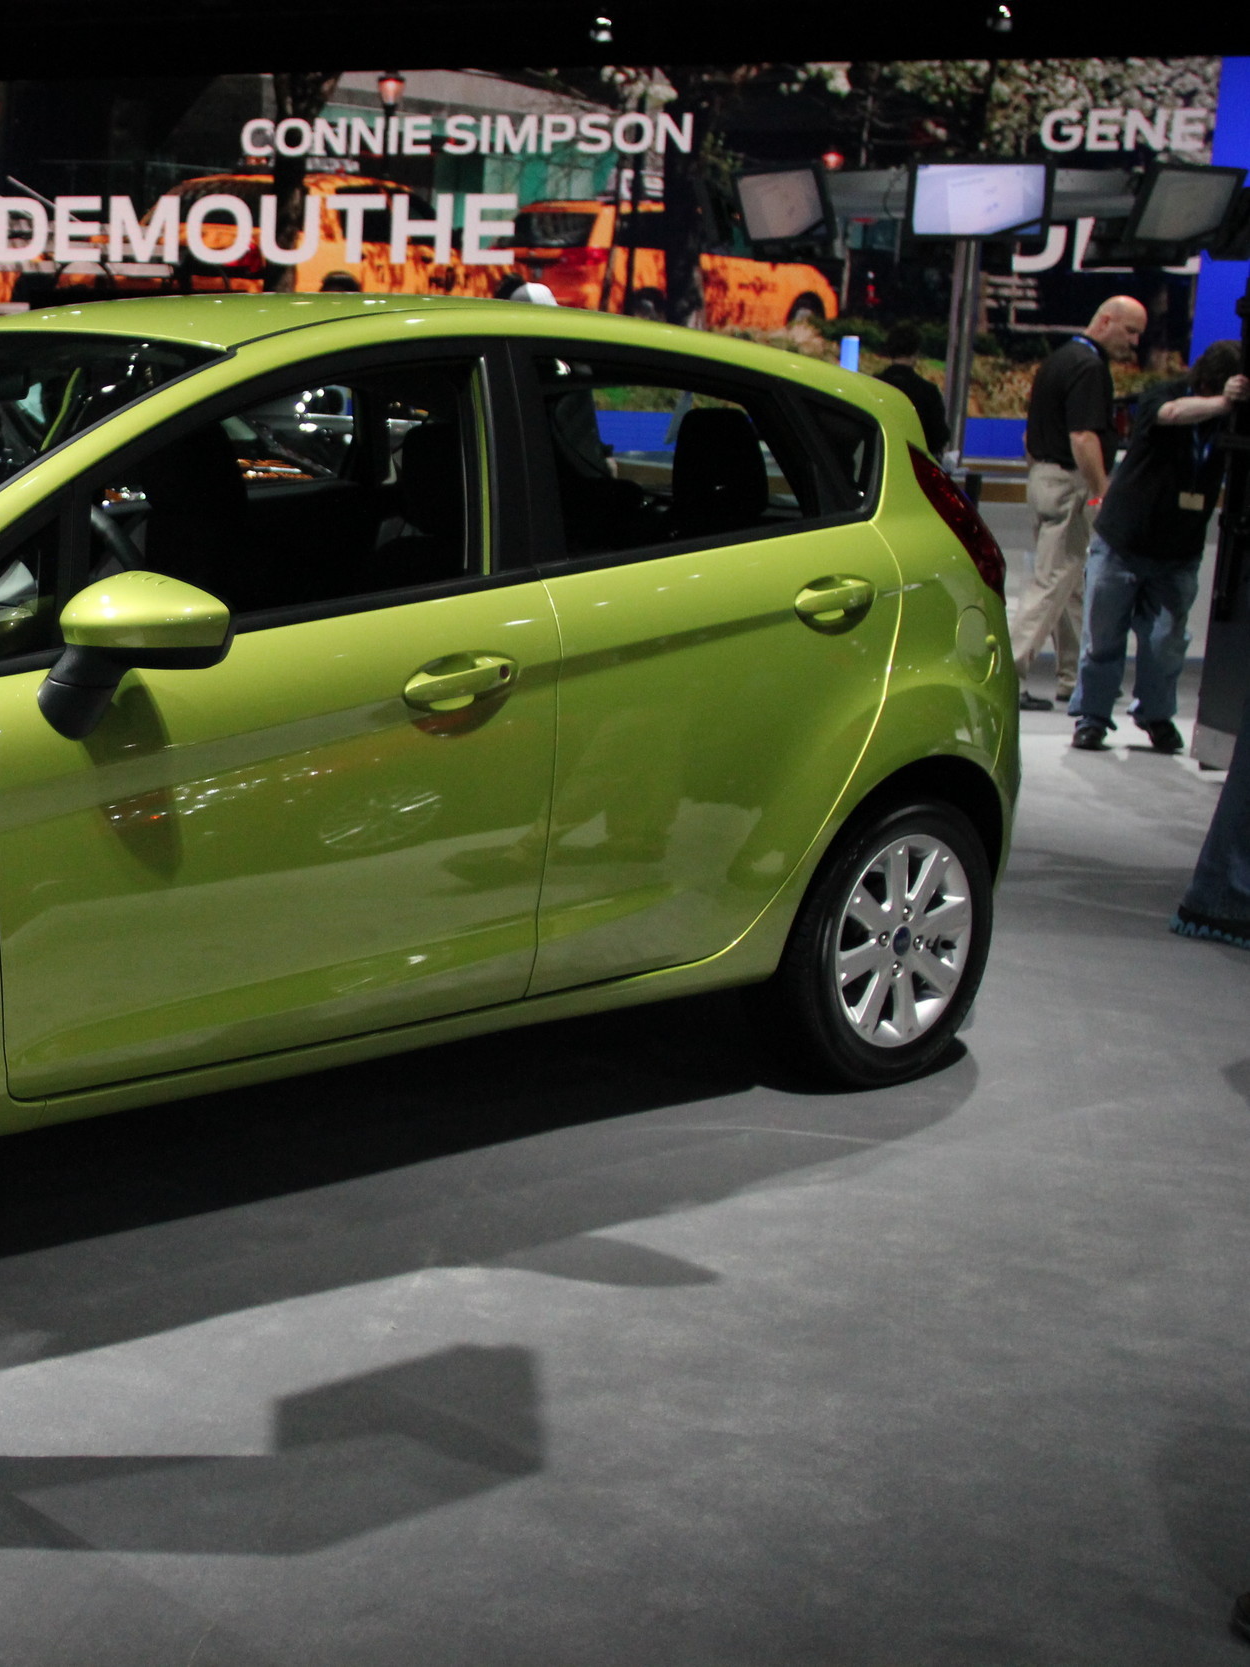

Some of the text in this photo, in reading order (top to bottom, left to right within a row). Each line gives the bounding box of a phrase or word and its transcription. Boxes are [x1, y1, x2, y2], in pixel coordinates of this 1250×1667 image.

[241, 112, 693, 158] CONNIE SIMPSON
[1040, 108, 1209, 152] GENE
